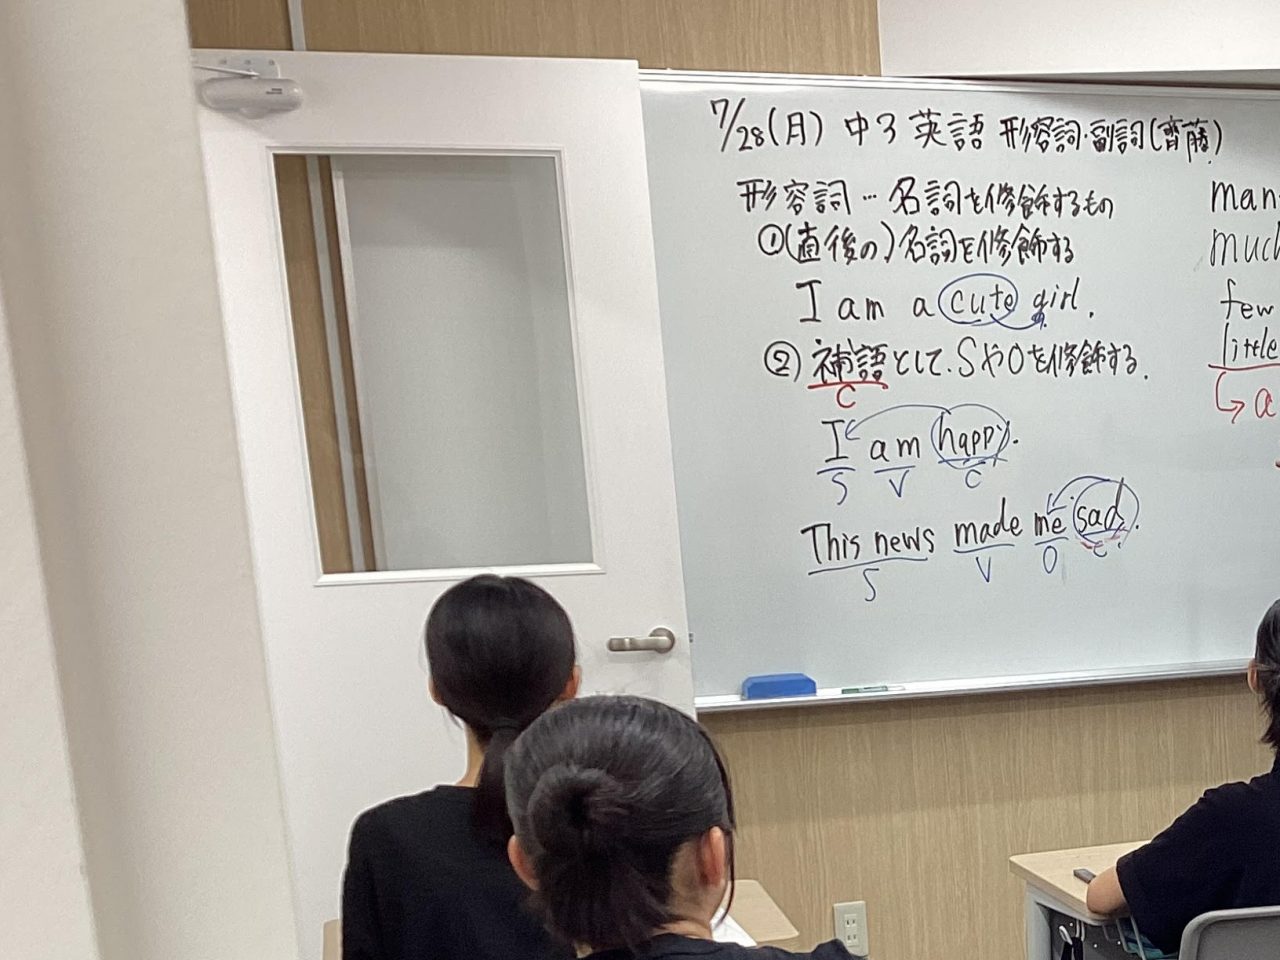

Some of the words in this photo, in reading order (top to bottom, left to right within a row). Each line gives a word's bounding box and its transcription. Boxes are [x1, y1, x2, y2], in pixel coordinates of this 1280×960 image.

[710, 97, 823, 152] 7/28(月)
[844, 110, 897, 146] 中3
[908, 107, 985, 151] 英語
[736, 178, 852, 216] 形容詞
[889, 176, 1114, 221] 名詞を修飾するもの
[795, 279, 821, 323] I
[838, 299, 885, 321] am
[912, 299, 935, 319] a
[949, 283, 1017, 315] cute
[1220, 278, 1275, 320] few
[1221, 322, 1279, 367] little
[836, 384, 856, 408] C
[821, 419, 849, 463] I
[869, 433, 921, 462] am
[831, 472, 848, 505] S
[965, 469, 982, 488] C
[801, 523, 861, 565] This
[875, 528, 936, 557] news
[955, 497, 1023, 547] made
[1033, 511, 1068, 537] me
[976, 556, 992, 583] V
